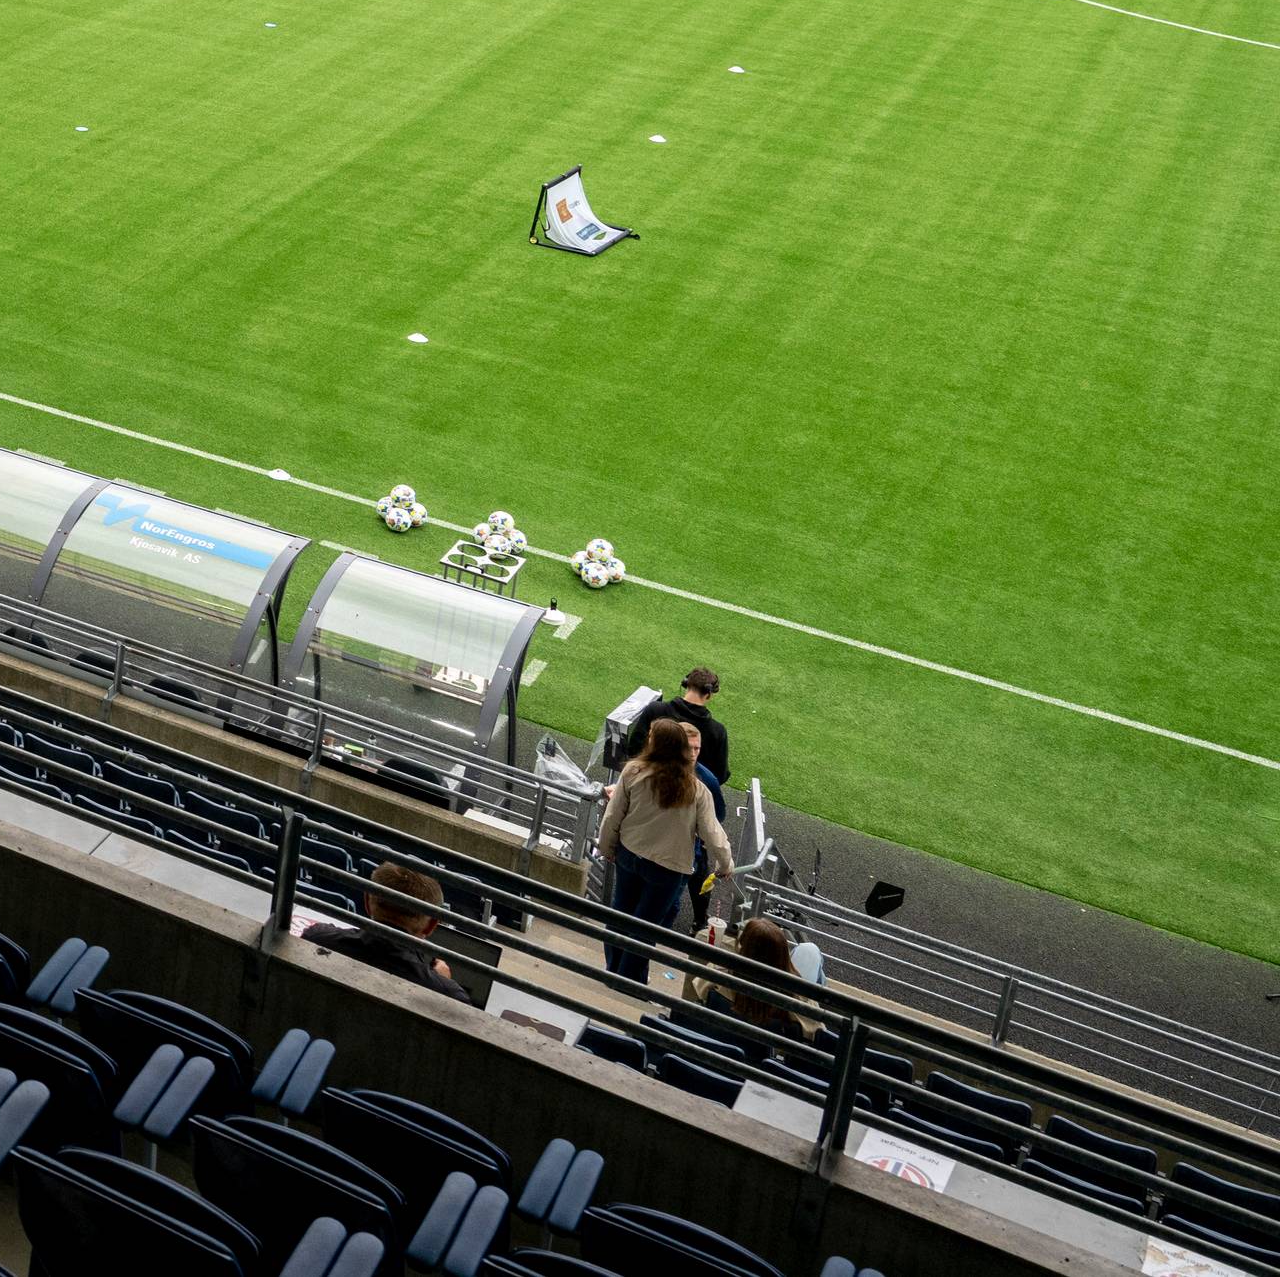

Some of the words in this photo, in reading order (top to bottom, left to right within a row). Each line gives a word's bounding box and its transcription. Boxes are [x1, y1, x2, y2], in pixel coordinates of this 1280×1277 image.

[140, 520, 216, 550] NorEngros
[129, 536, 178, 559] Kjosavik
[183, 552, 203, 564] AS
